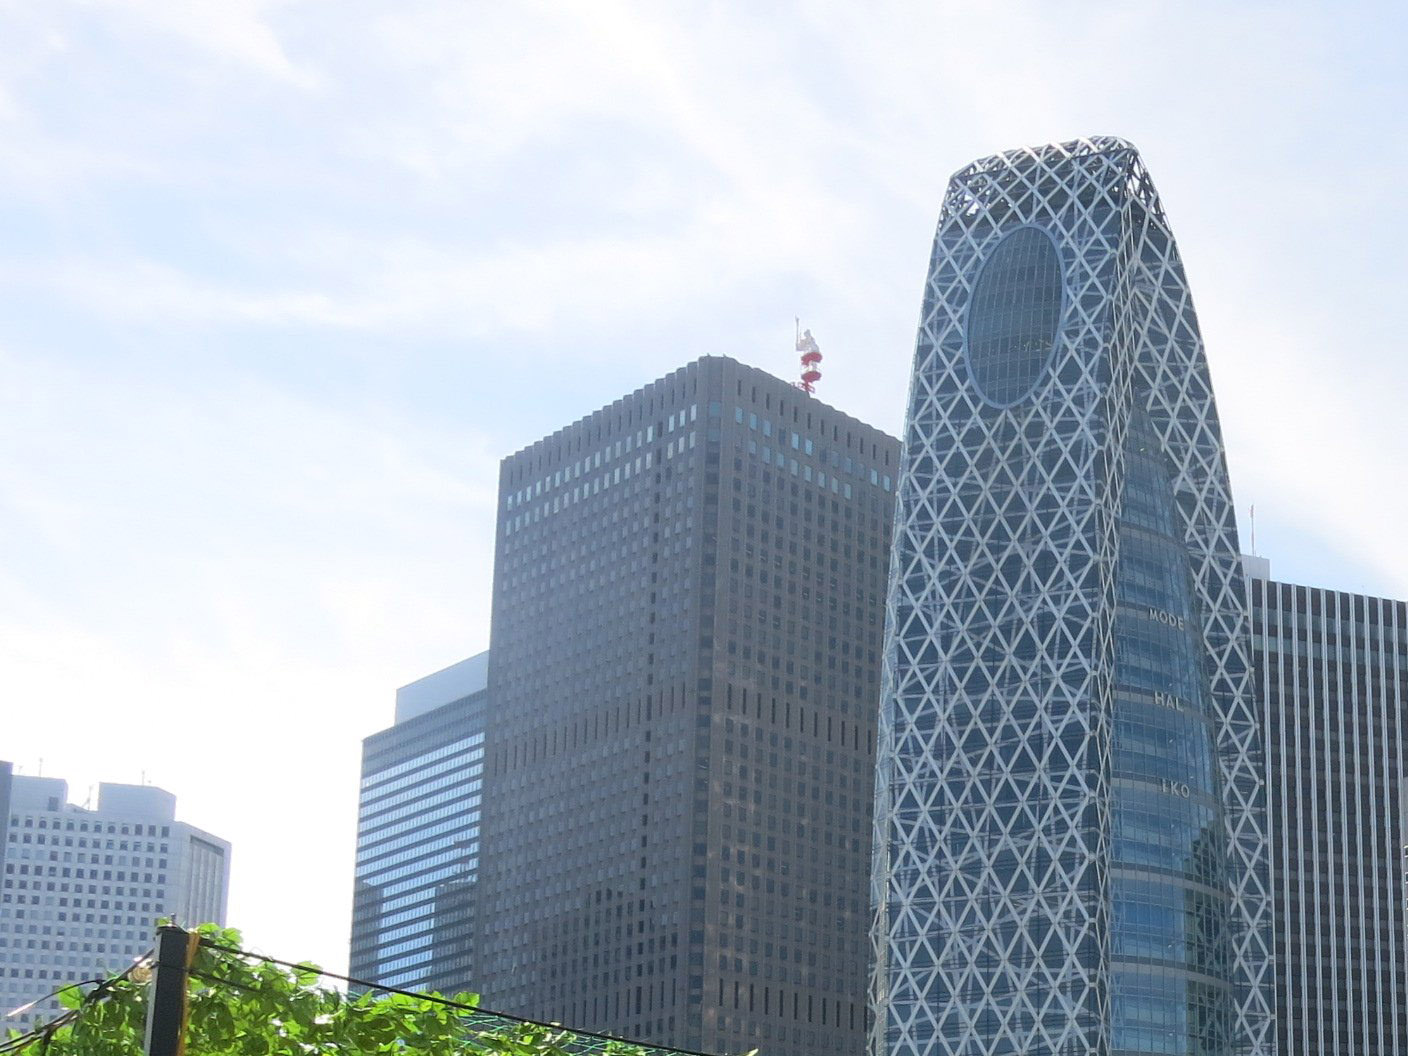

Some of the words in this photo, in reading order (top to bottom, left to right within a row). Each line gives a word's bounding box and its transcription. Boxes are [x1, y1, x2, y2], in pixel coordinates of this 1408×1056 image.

[1149, 607, 1184, 631] MODE
[1154, 690, 1184, 712] HAL
[1162, 778, 1190, 798] IKO
